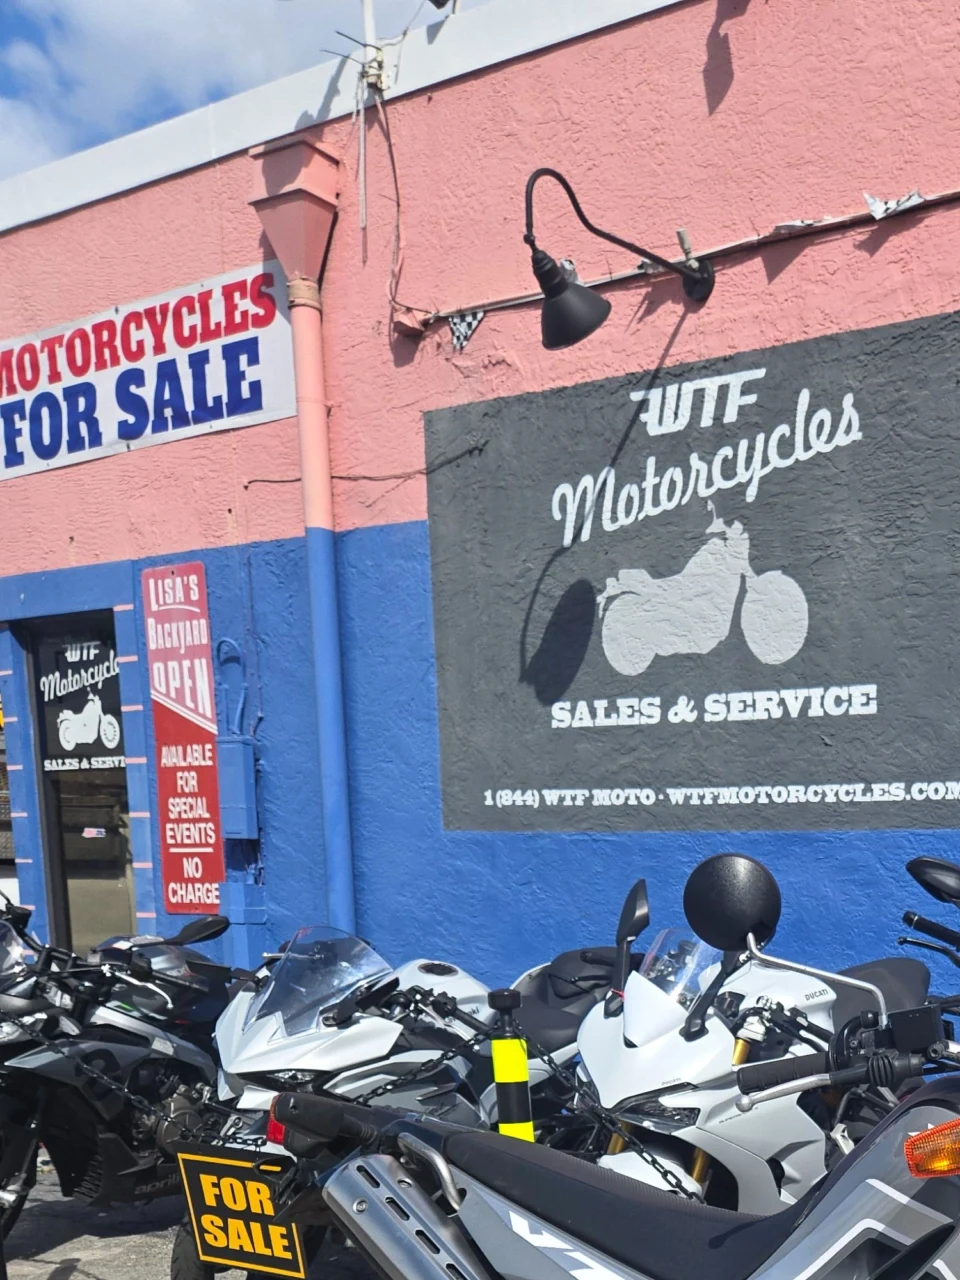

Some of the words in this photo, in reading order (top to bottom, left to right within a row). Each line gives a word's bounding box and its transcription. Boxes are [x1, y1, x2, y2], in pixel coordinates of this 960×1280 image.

[0, 381, 103, 470] FOR
[115, 336, 263, 442] SALE
[629, 368, 767, 437] WTF
[552, 388, 863, 548] Motorcycles
[62, 641, 101, 662] WTF
[152, 657, 213, 719] OPEN
[551, 697, 661, 729] SALES
[667, 695, 698, 724] &
[704, 684, 877, 722] SERVICE
[44, 758, 80, 771] SALES
[80, 757, 90, 770] &
[91, 756, 126, 769] SERVI
[161, 743, 214, 768] AVAILABLE
[176, 771, 199, 793] FOR
[168, 796, 211, 819] SPECIAL
[484, 789, 494, 806] 1
[496, 789, 540, 808] (844)
[541, 789, 589, 806] WTF
[592, 788, 656, 806] MOTO
[165, 822, 216, 845] EVENTS
[183, 856, 203, 878] NO
[168, 882, 220, 904] CHARGE
[804, 989, 829, 1001] DUCATI
[134, 1173, 181, 1195] aprili
[200, 1173, 275, 1216] FOR
[201, 1214, 293, 1260] SALE
